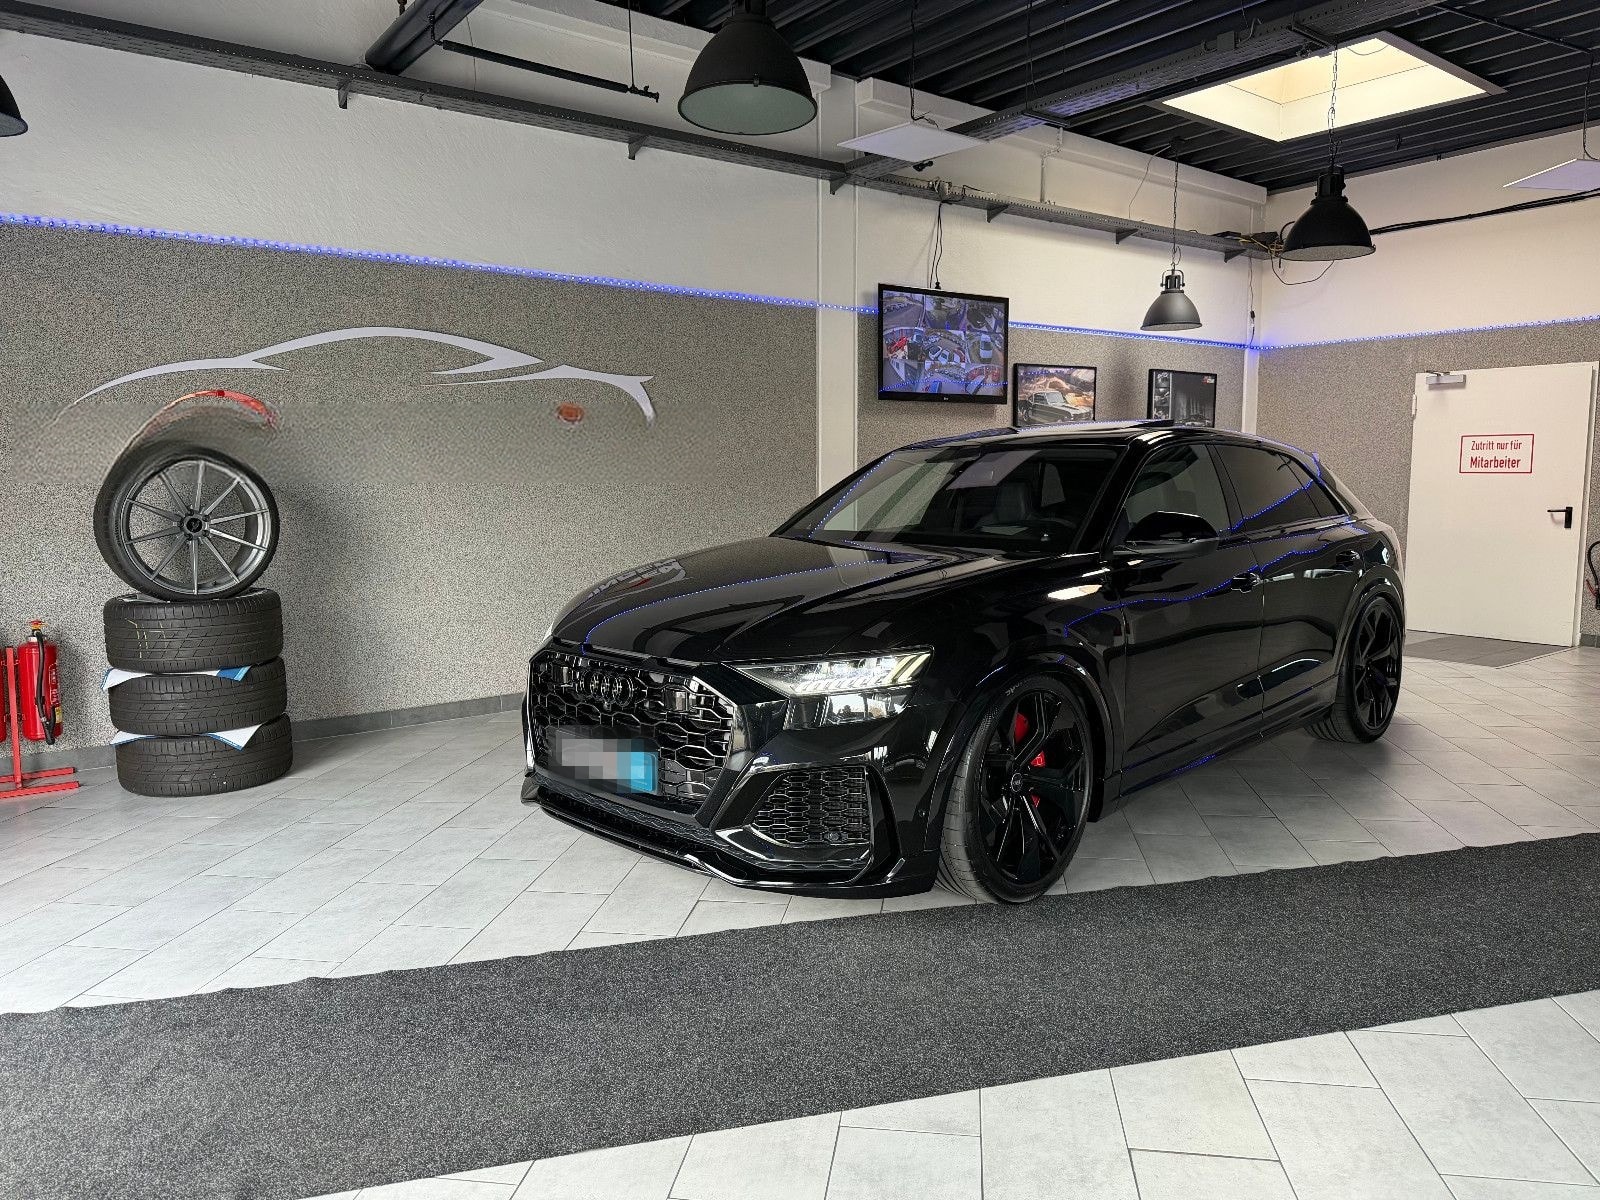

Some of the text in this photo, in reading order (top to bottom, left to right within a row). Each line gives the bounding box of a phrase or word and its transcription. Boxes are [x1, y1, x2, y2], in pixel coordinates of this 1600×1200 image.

[1471, 440, 1522, 451] Zutritt nur für
[1470, 456, 1521, 469] Mitarbeiter
